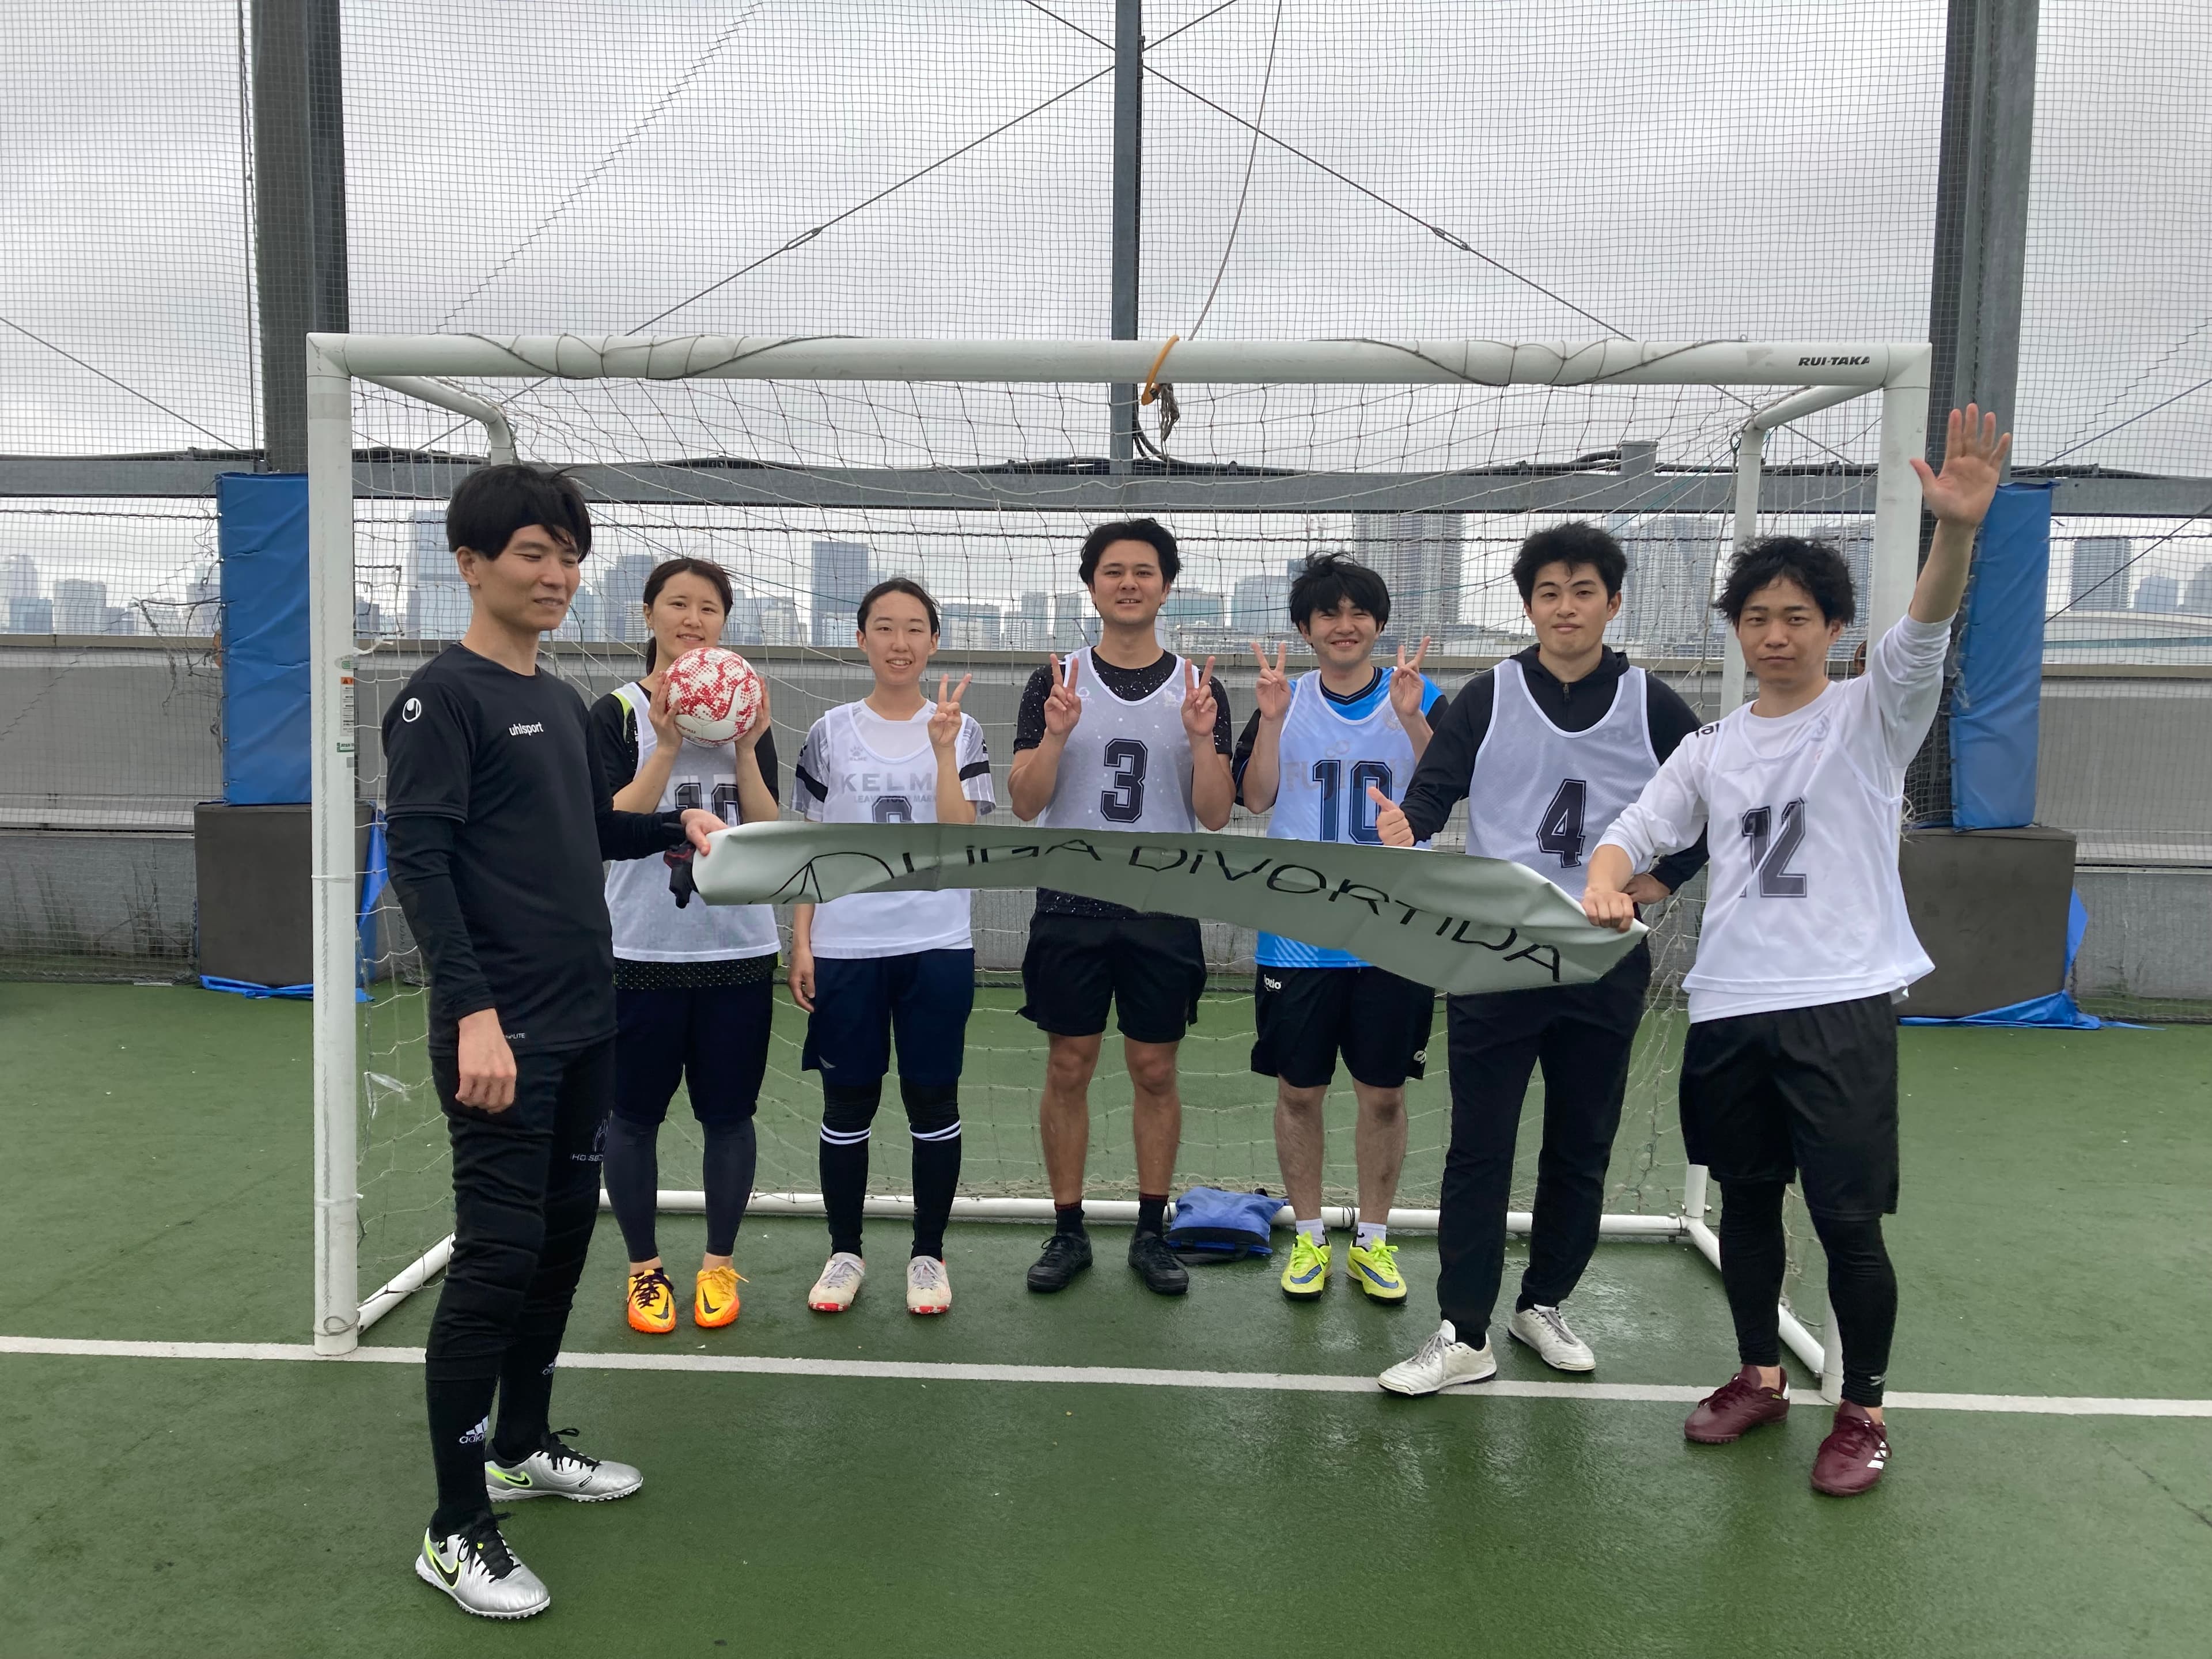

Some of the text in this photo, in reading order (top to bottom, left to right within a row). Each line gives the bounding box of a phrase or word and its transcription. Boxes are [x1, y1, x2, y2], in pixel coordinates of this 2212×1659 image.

[1798, 356, 1870, 366] RUI-TAKA
[509, 722, 544, 736] uhlsport
[842, 772, 933, 793] KELM
[1101, 738, 1147, 823] 3
[1312, 760, 1392, 845] 10
[1536, 779, 1586, 868] 4
[1739, 797, 1807, 898] 12
